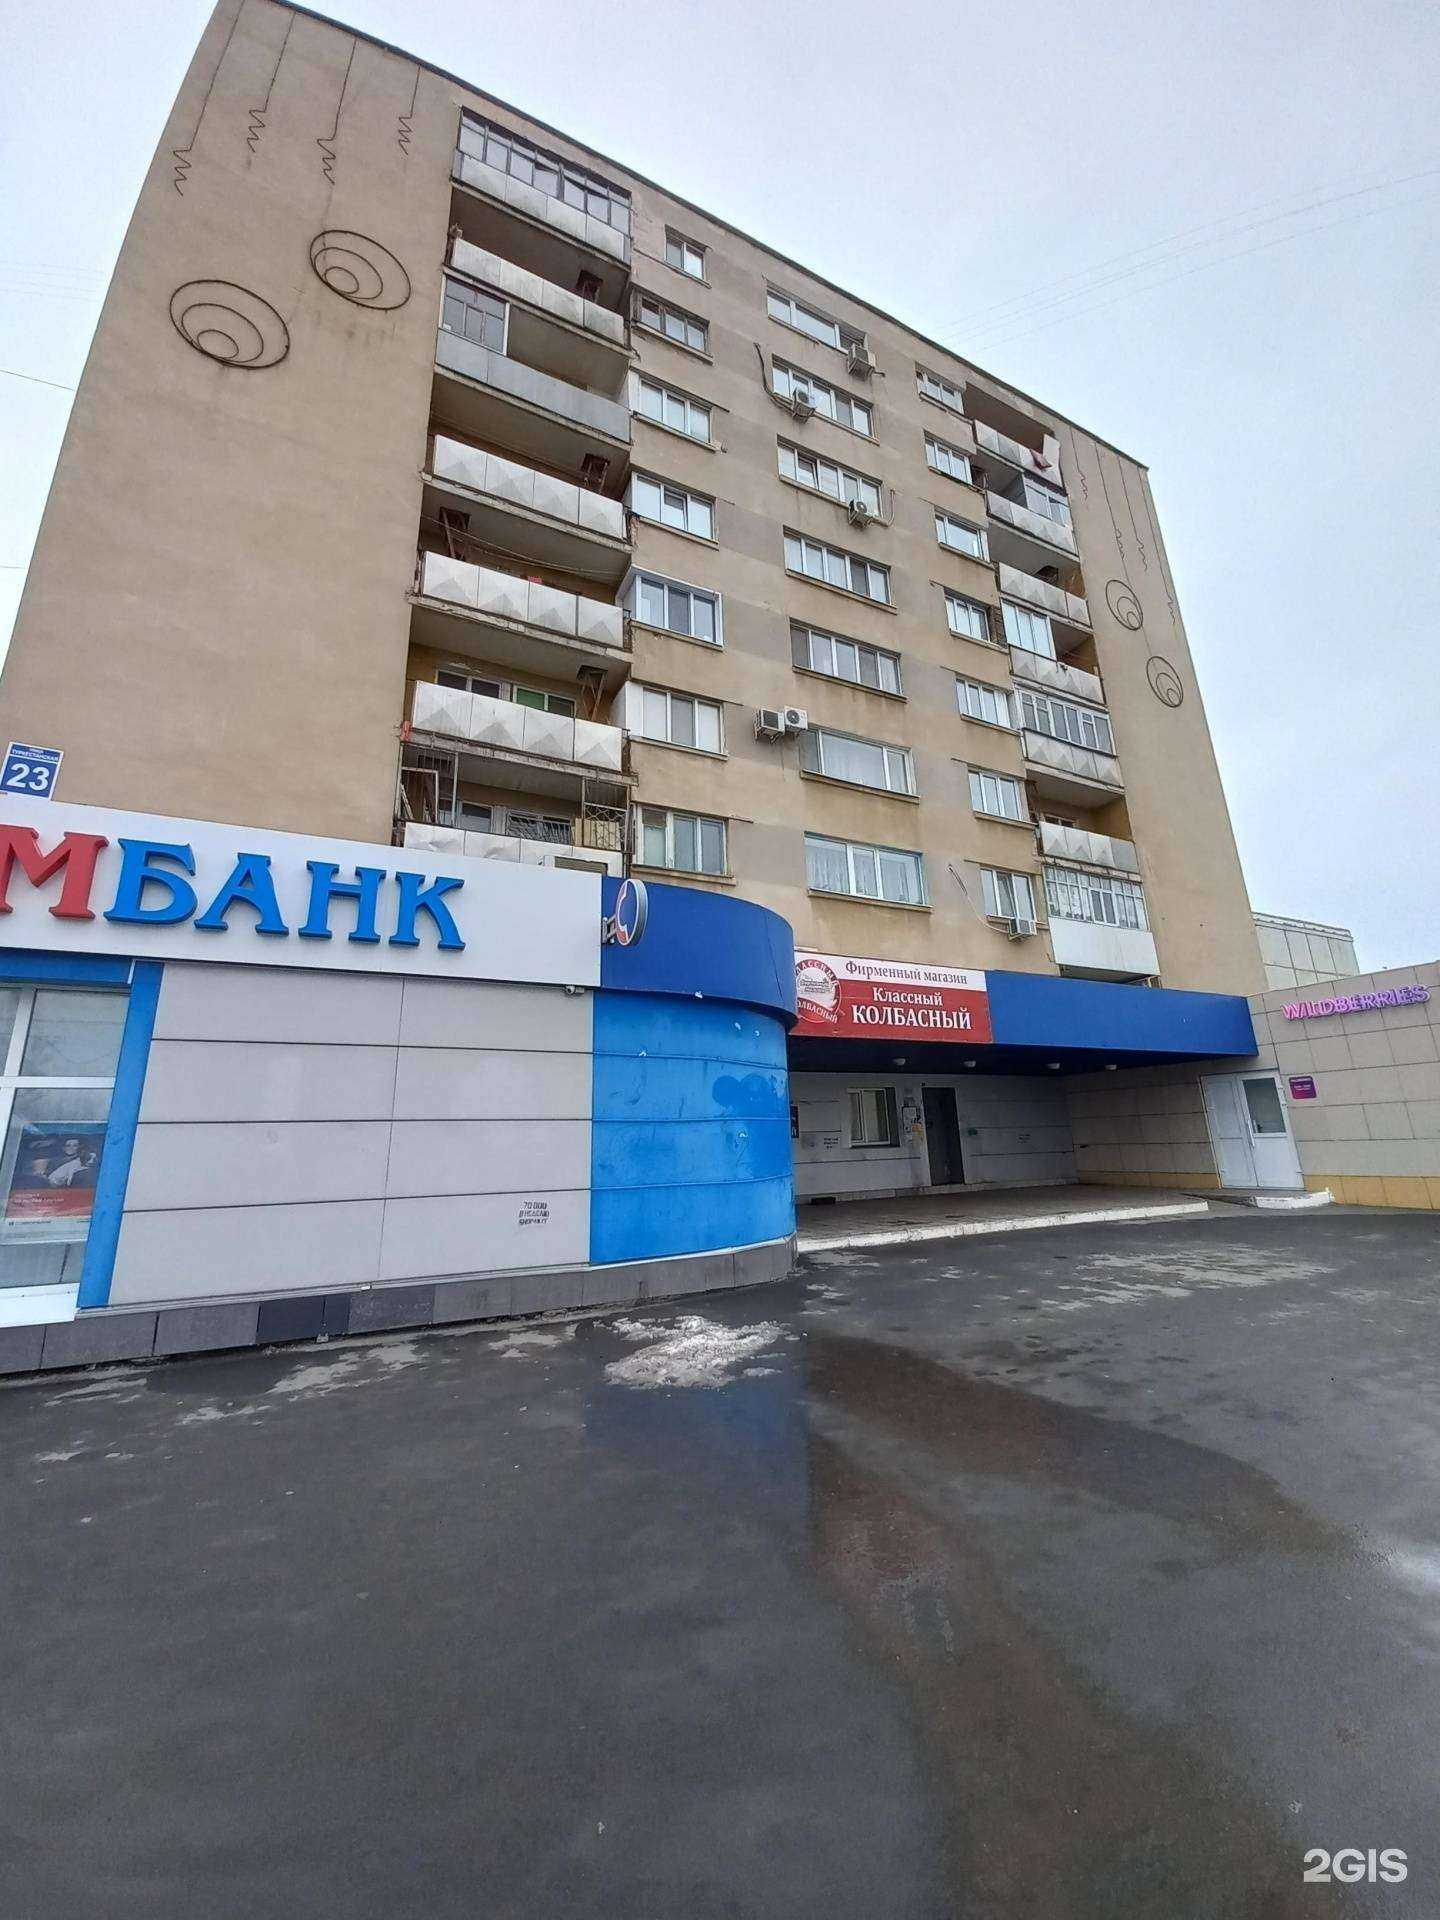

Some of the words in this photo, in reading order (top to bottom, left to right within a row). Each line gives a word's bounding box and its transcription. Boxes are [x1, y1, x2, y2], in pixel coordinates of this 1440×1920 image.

[6, 763, 49, 790] 23
[0, 824, 466, 951] МБАНК
[845, 960, 921, 980] Фирменный
[923, 972, 968, 985] магазин
[873, 987, 943, 1006] Классный
[1282, 985, 1430, 1020] WILDBERRIES
[852, 1004, 972, 1030] КОЛБАСНЫЙ
